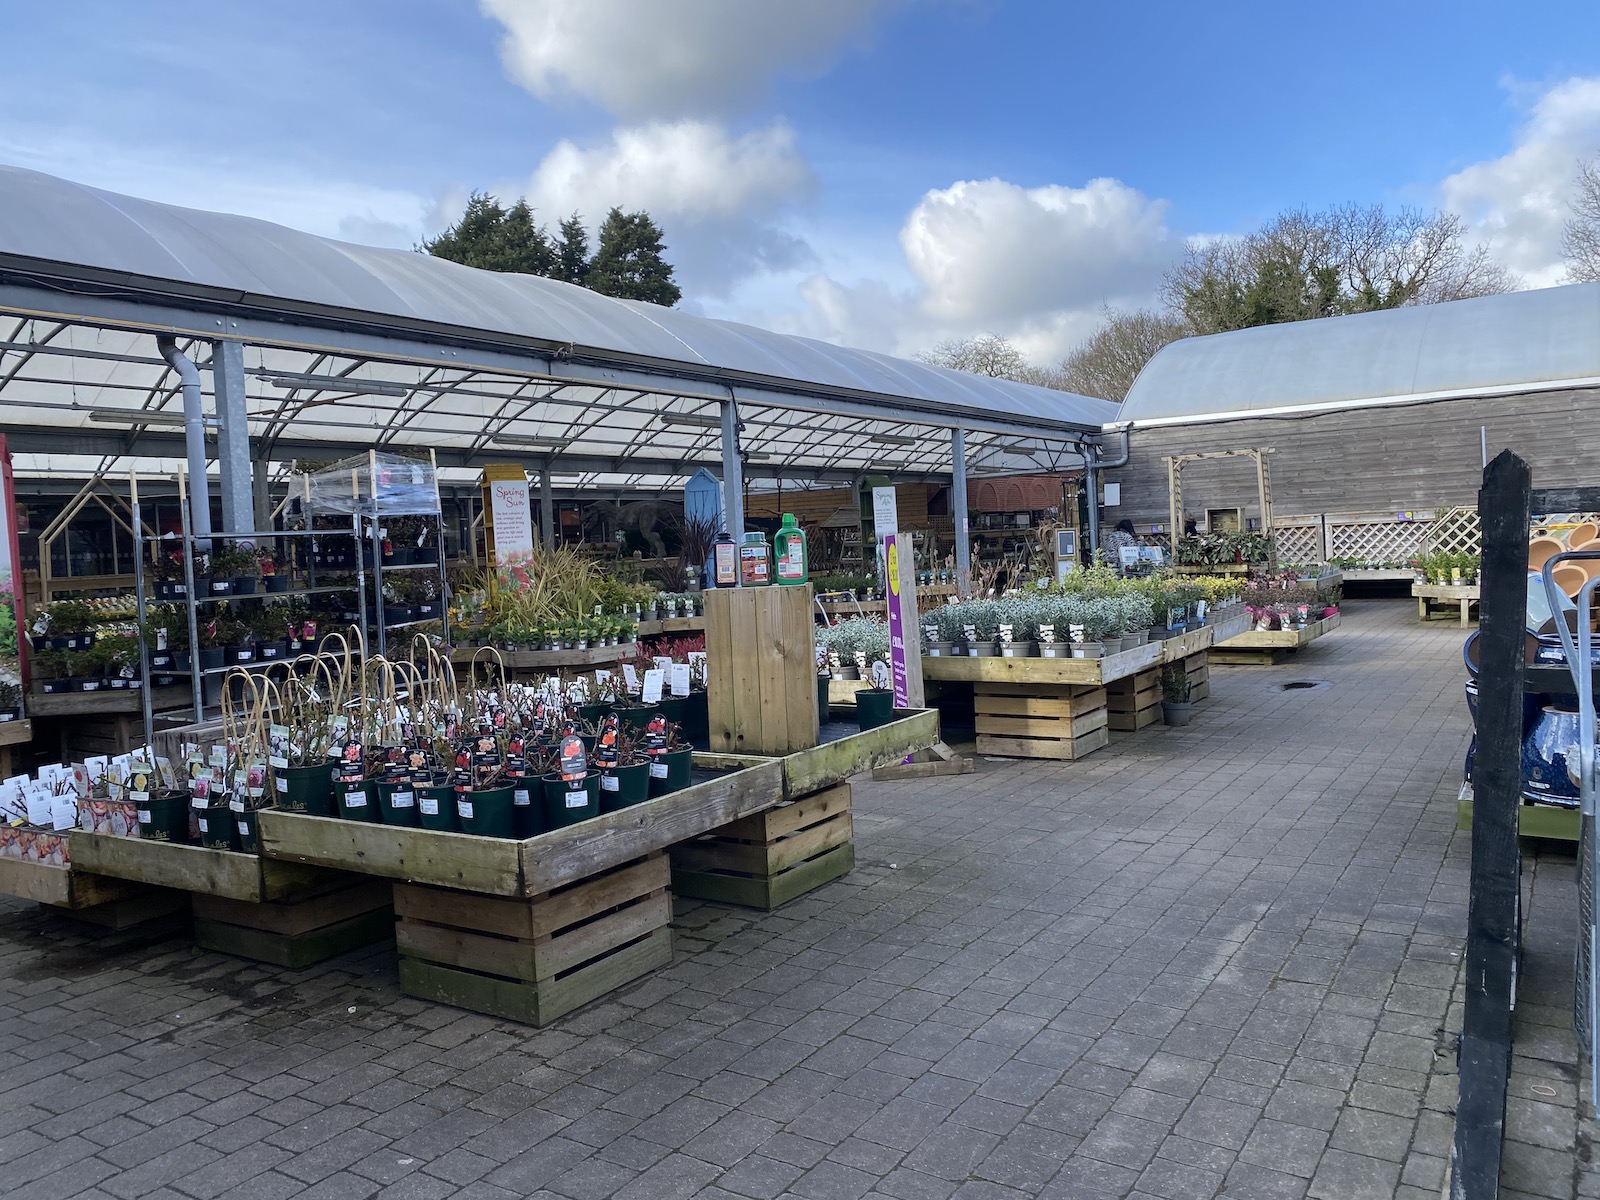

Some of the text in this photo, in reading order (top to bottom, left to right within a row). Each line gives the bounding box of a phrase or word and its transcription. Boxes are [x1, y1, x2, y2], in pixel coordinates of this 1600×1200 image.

[496, 486, 525, 499] Spring
[876, 490, 893, 500] Spring
[506, 496, 525, 508] Sun
